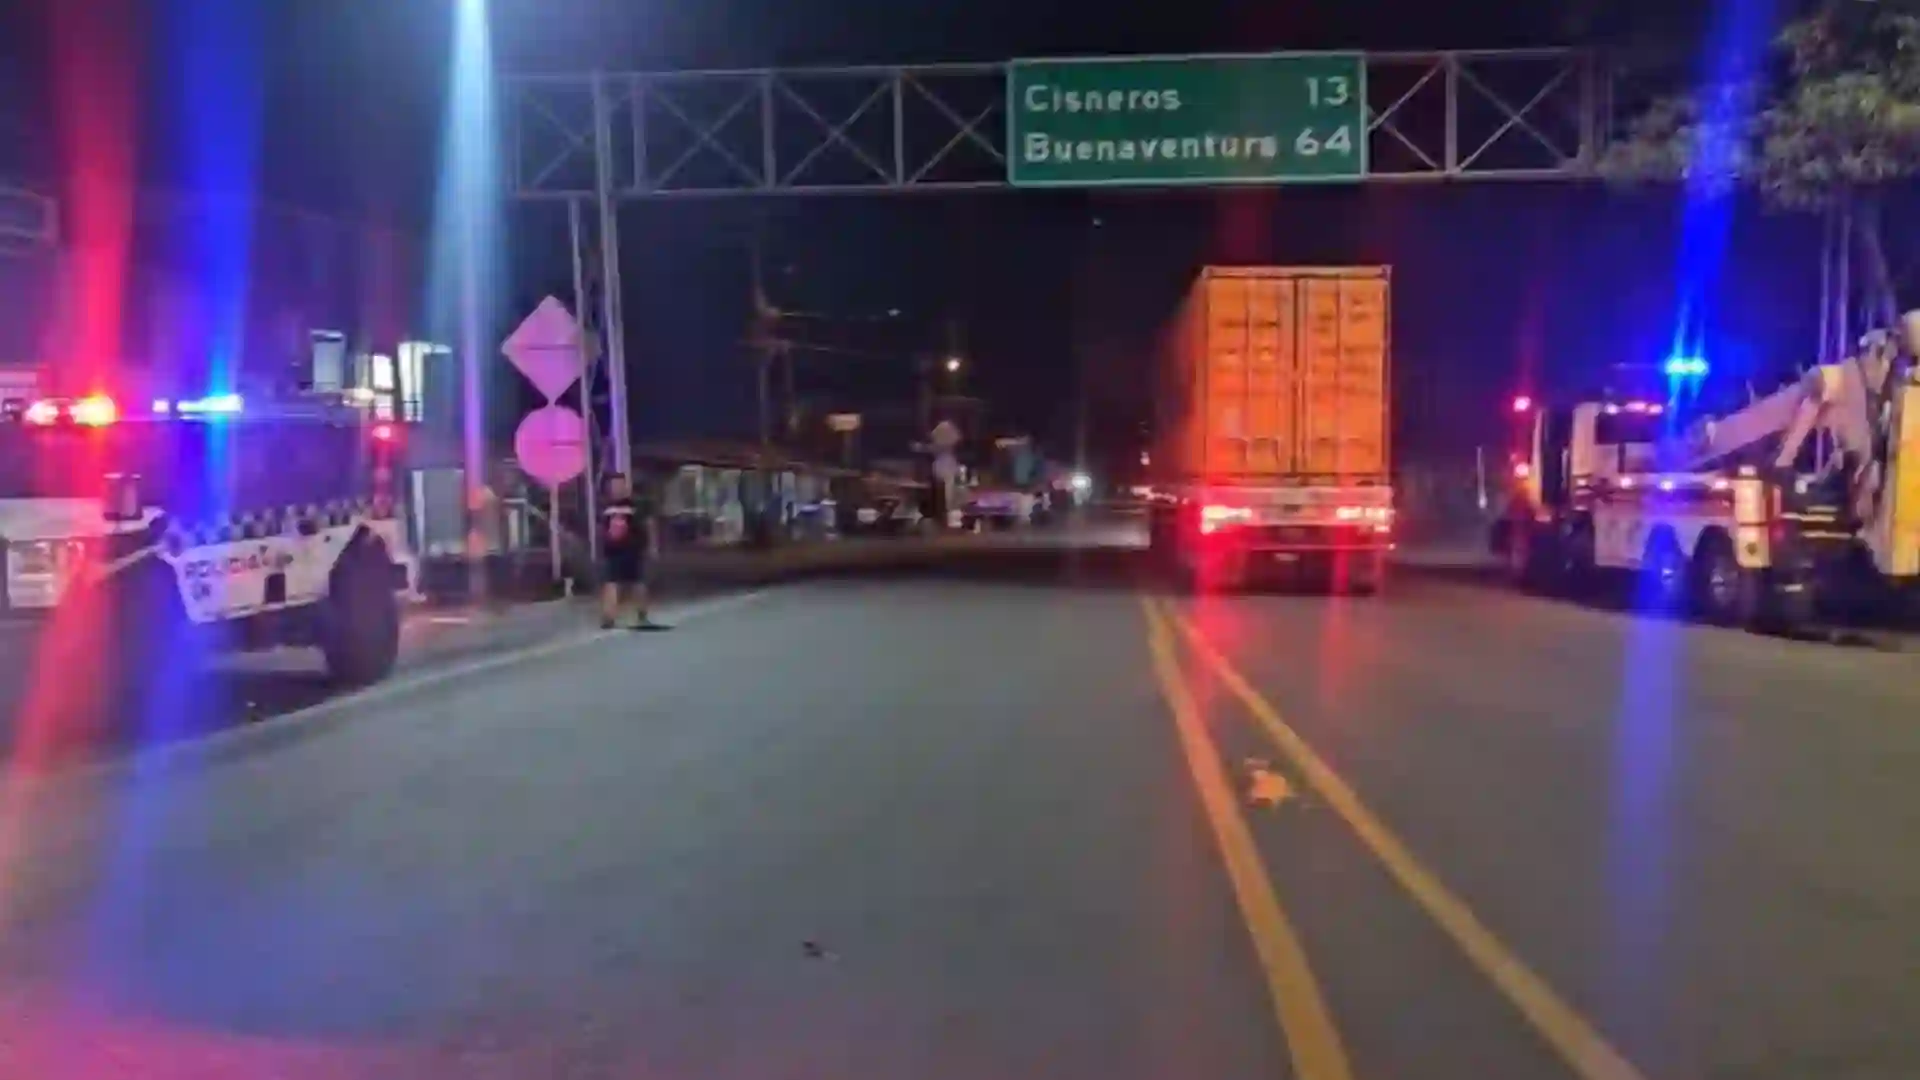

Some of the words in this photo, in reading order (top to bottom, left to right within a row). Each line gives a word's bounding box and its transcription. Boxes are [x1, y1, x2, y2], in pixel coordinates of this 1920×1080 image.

[1025, 84, 1181, 112] Cisneros
[1307, 75, 1348, 108] 13
[1024, 132, 1277, 163] Buenaventura
[1295, 125, 1351, 157] 64
